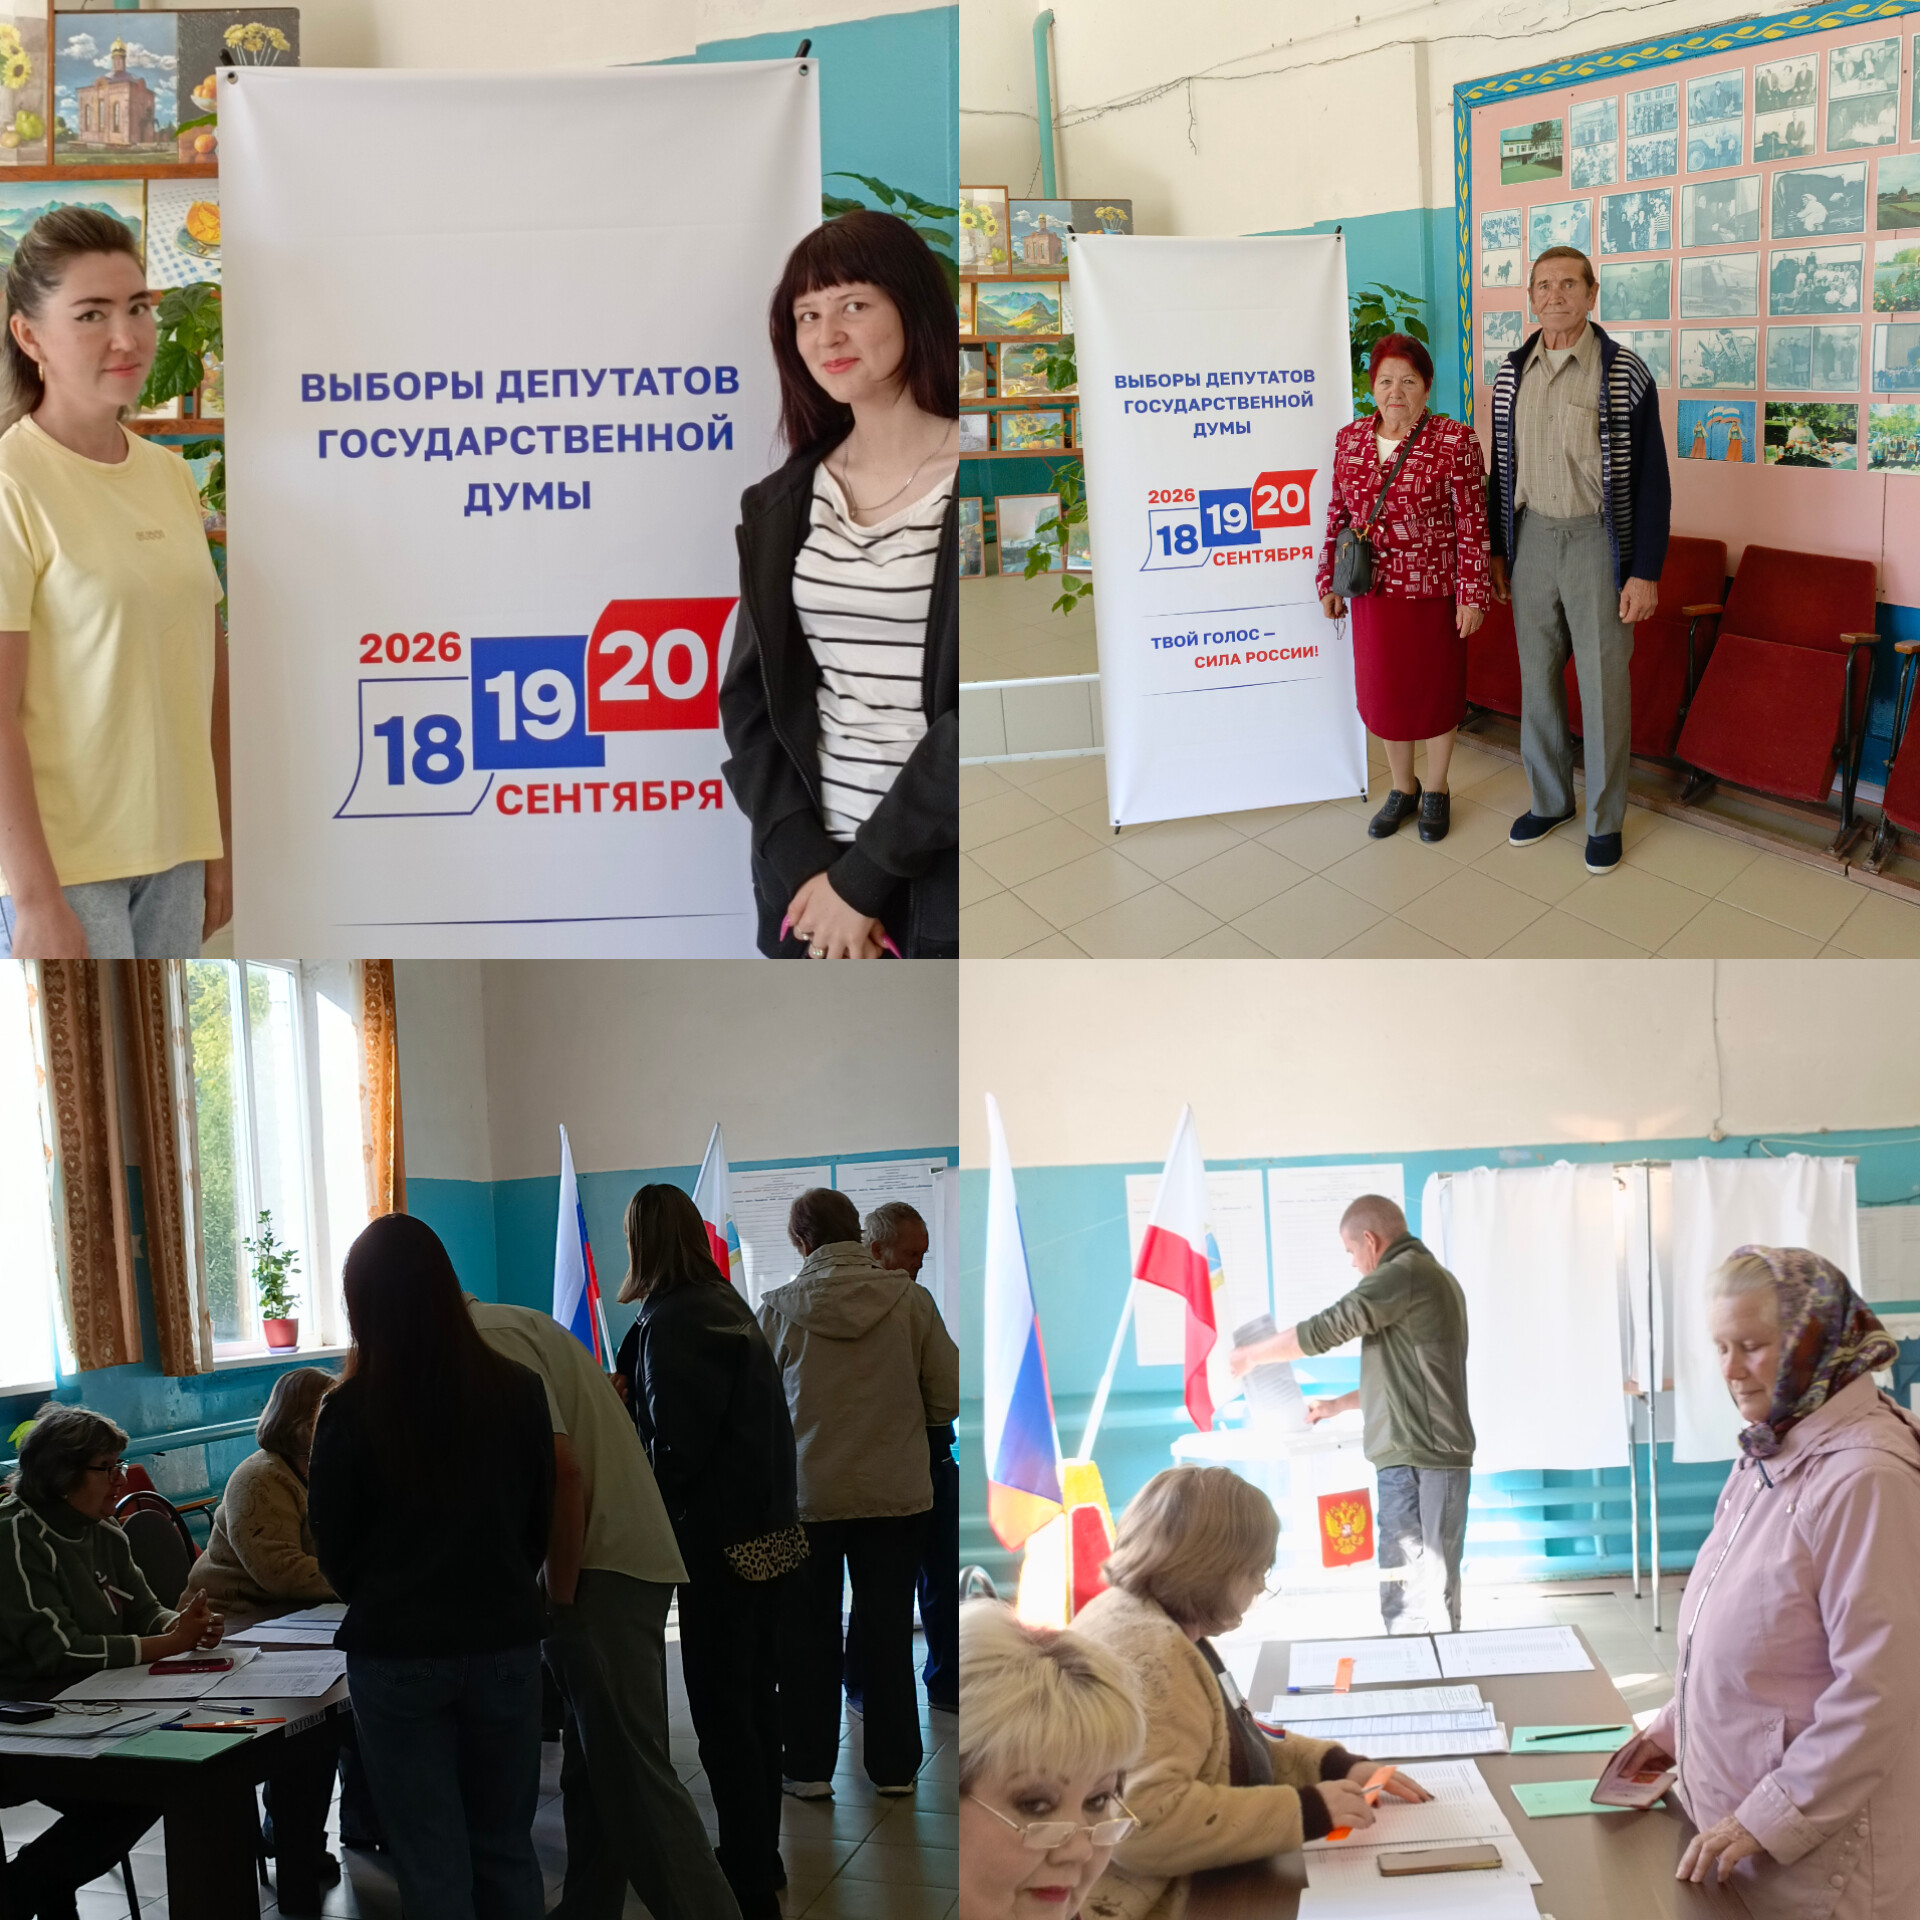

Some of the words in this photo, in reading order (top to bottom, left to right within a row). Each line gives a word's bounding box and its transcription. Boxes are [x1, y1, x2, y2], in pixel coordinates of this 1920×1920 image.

[302, 371, 482, 402] ВЫБОРЫ
[496, 366, 740, 403] ДЕПУТАТОВ
[1115, 373, 1201, 389] ВЫБОРЫ
[1206, 369, 1315, 388] ДЕПУТАТОВ
[1124, 391, 1313, 414] ГОСУДАРСТВЕННОЙ
[319, 413, 733, 462] ГОСУДАРСТВЕННОЙ
[1194, 421, 1251, 438] ДУМЫ
[464, 481, 590, 517] ДУМЫ
[1148, 488, 1195, 503] 2026
[1157, 524, 1199, 556] 18
[1206, 503, 1248, 535] 19
[1257, 483, 1305, 515] 20
[1213, 546, 1314, 566] СЕНТЯБРЯ
[360, 631, 461, 664] 2026
[1151, 631, 1199, 649] ТВОЙ
[1204, 629, 1260, 645] ГОЛОС
[1195, 654, 1242, 669] СИЛА
[1246, 645, 1319, 664] РОССИИ!
[374, 714, 465, 785] 18
[485, 668, 576, 740] 19
[598, 628, 708, 701] 20
[496, 779, 723, 815] СЕНТЯБРЯ
